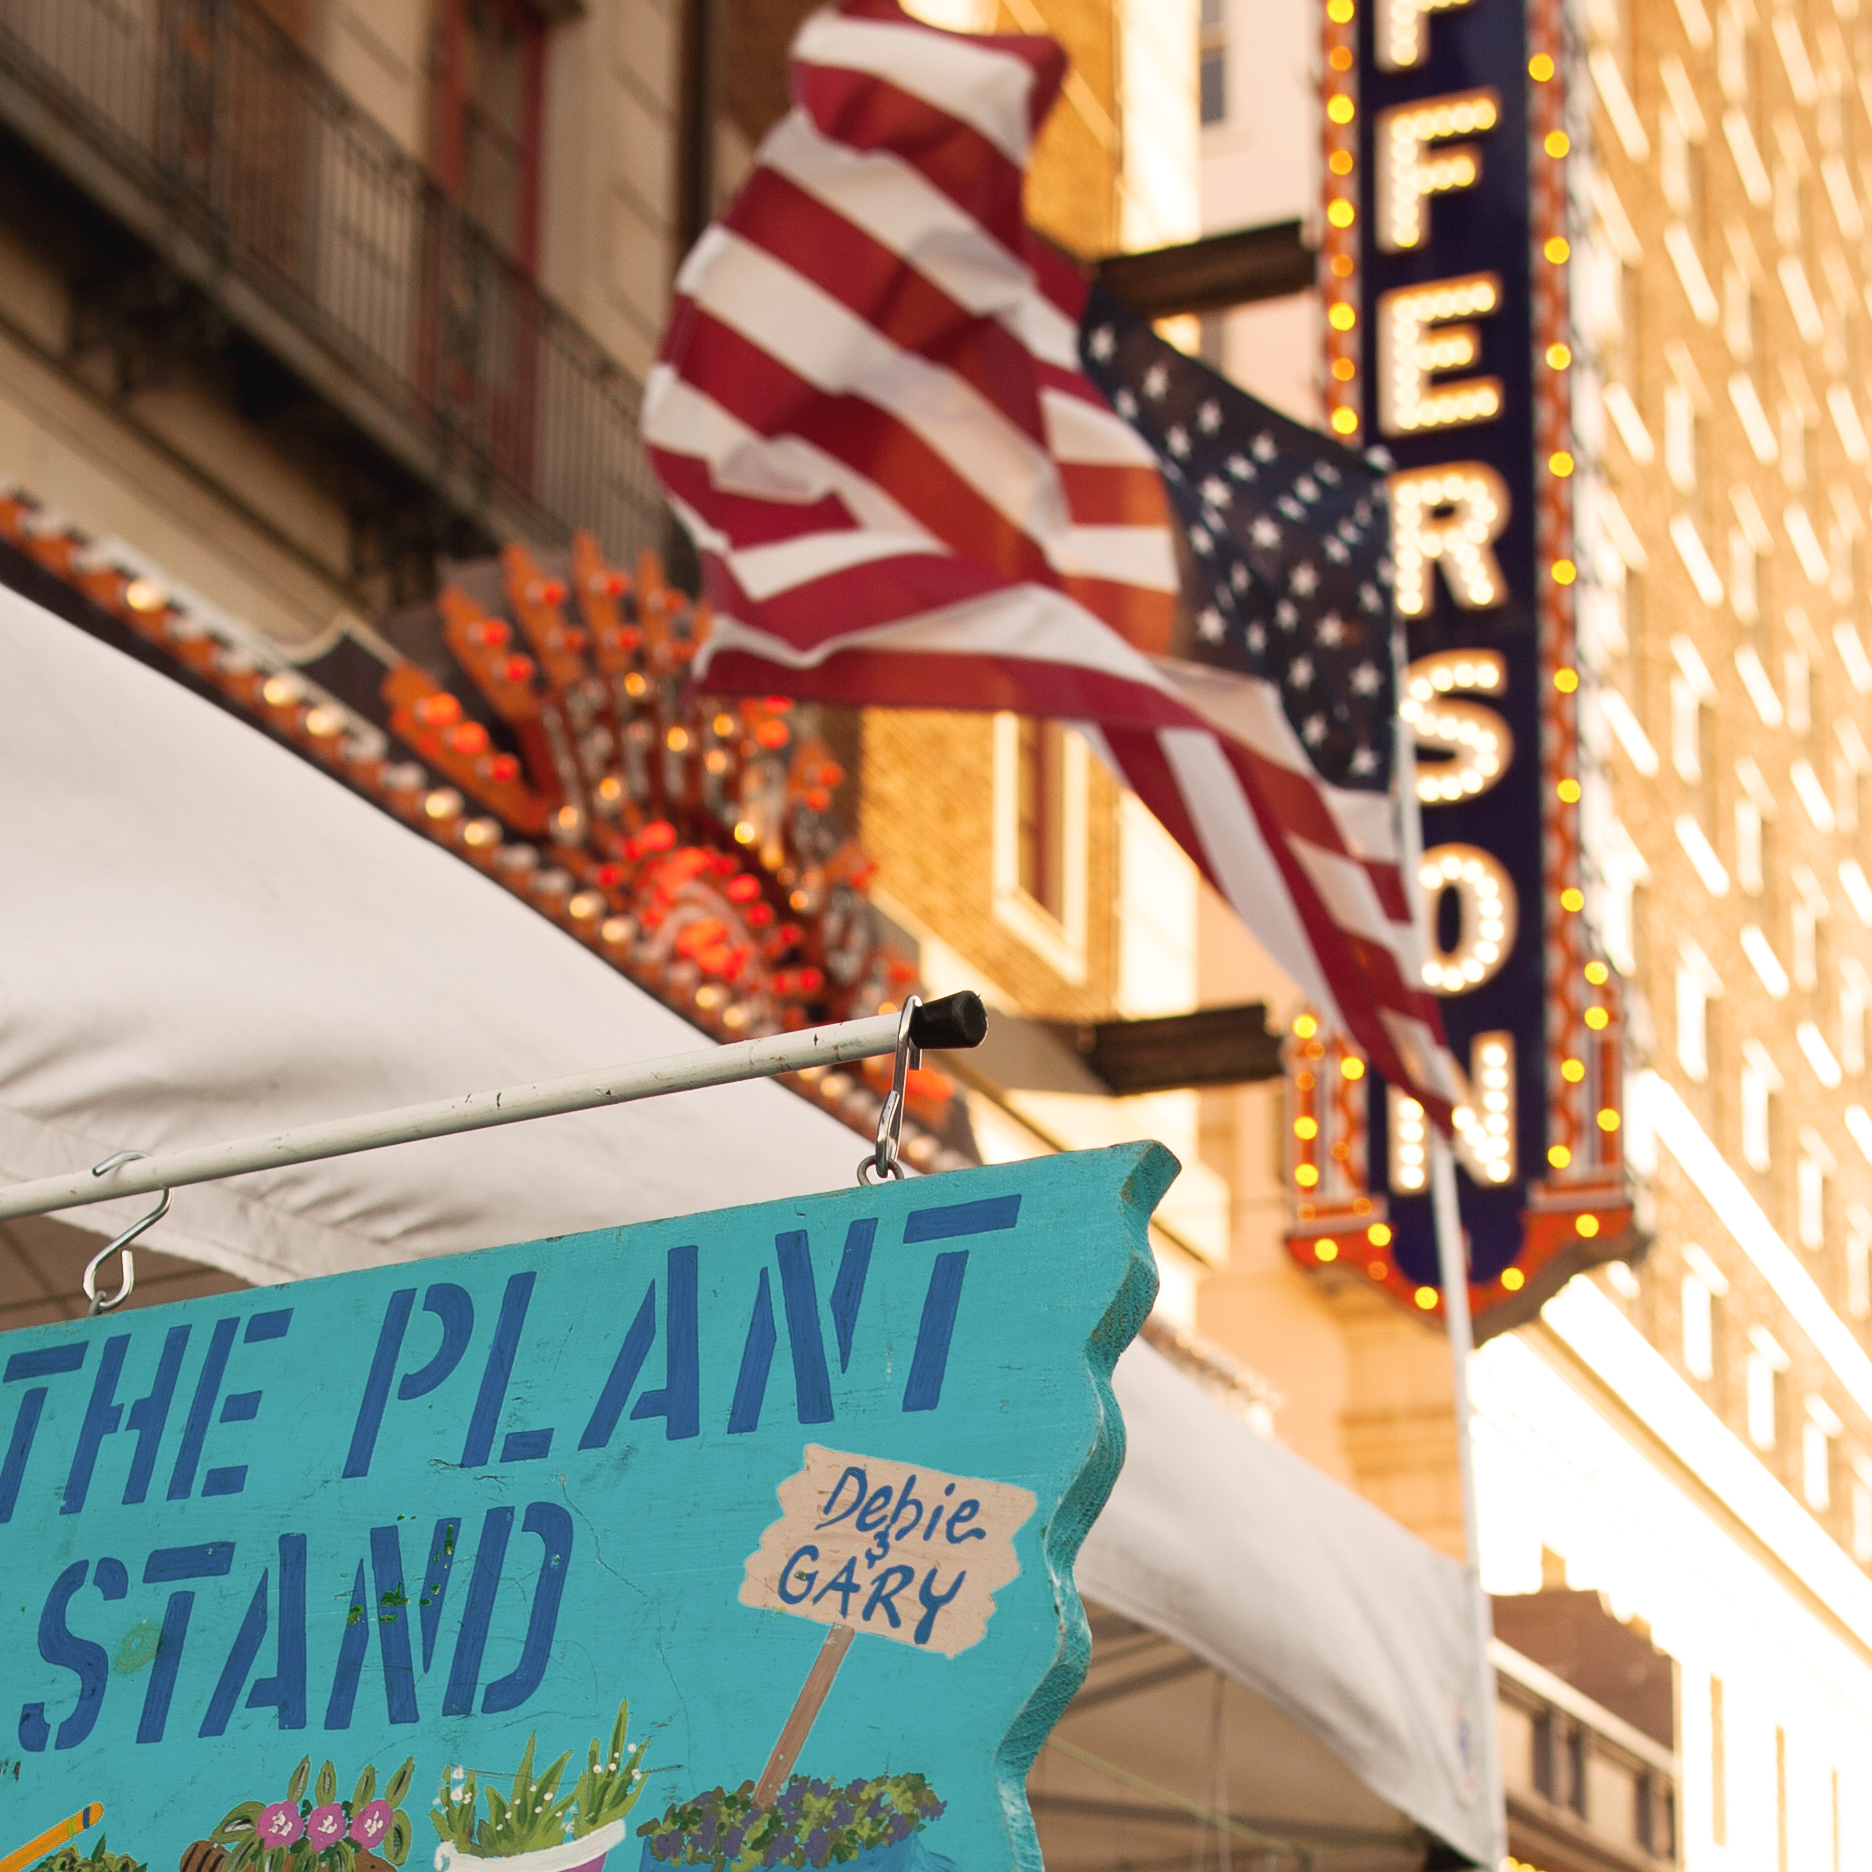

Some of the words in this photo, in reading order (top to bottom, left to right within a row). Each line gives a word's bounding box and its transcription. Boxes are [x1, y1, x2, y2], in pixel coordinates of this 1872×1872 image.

[341, 1194, 1022, 1480] PLANT
[18, 1502, 574, 1752] STAND
[778, 1545, 967, 1645] GARY
